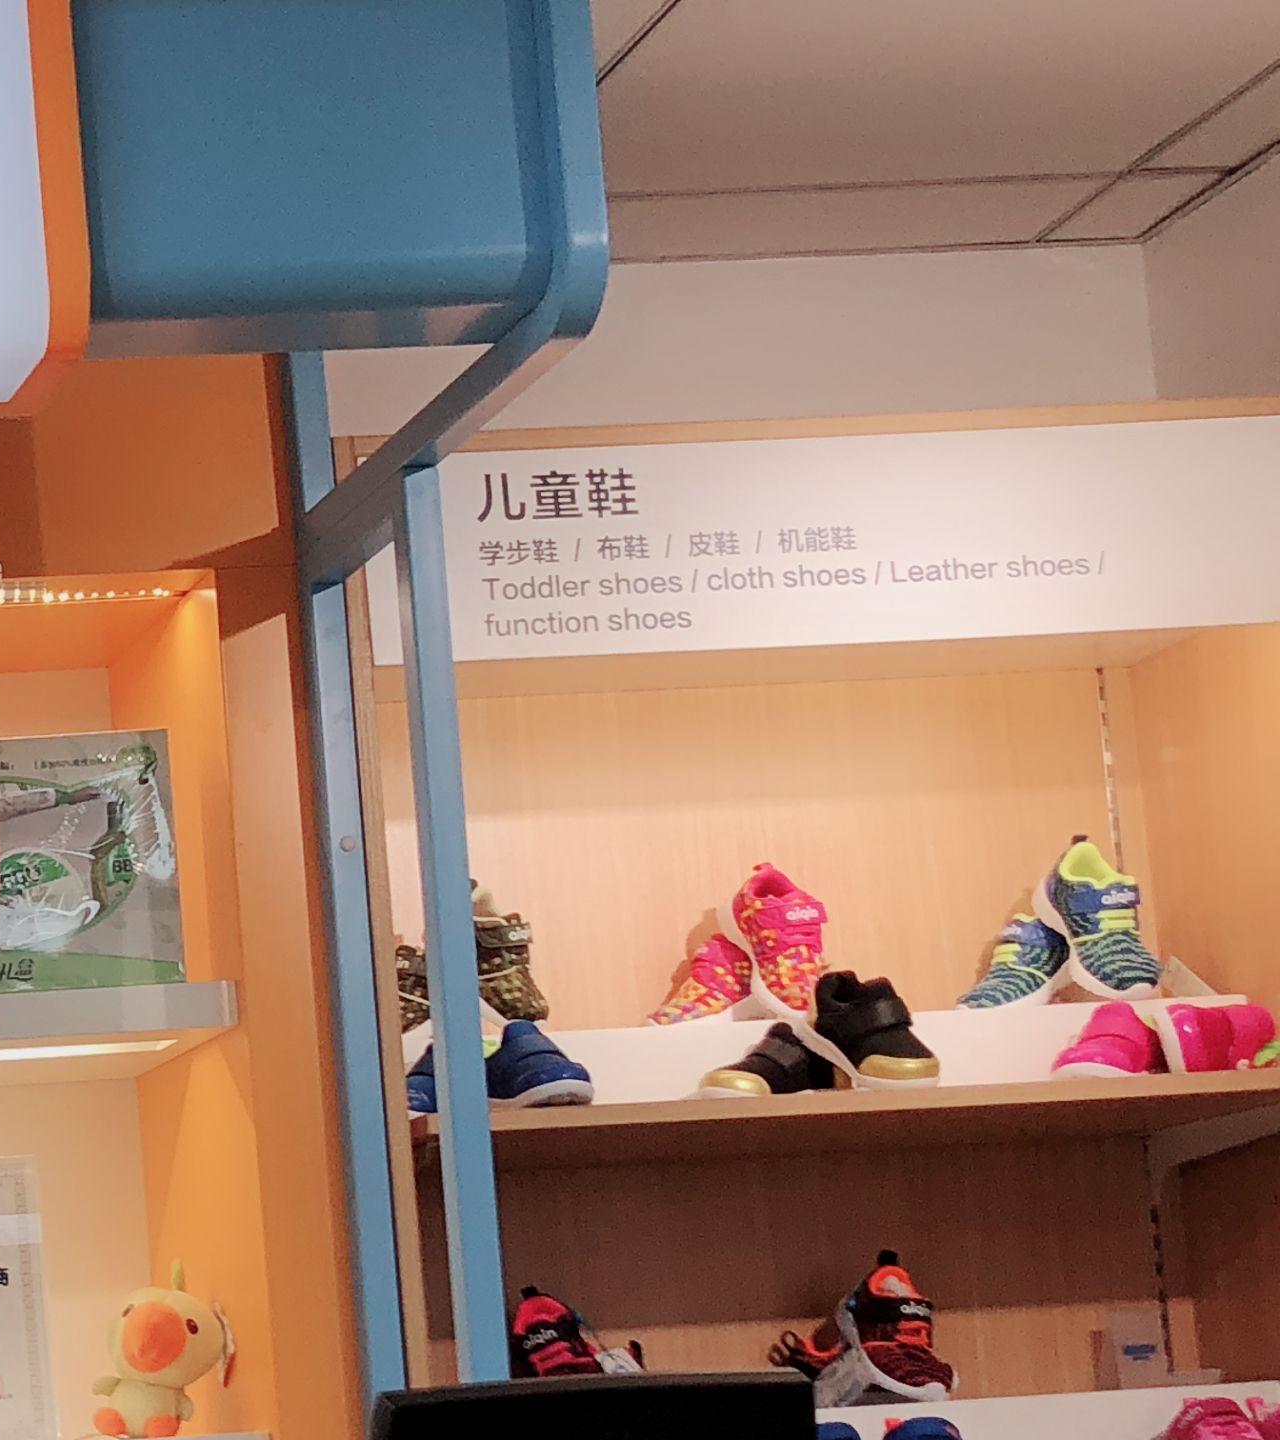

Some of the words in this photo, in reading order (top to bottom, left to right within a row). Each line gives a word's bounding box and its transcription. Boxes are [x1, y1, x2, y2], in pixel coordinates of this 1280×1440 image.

[476, 467, 640, 523] 儿童鞋
[478, 537, 559, 567] 学步鞋
[596, 535, 651, 563] 布鞋
[687, 530, 741, 559] 皮鞋
[777, 525, 858, 554] 机能鞋
[482, 574, 591, 602] Toddler
[597, 570, 684, 597] shoes
[706, 564, 776, 592] cloth
[782, 560, 868, 588] shoes
[890, 555, 998, 584] Leather
[1004, 551, 1091, 580] shoes
[484, 609, 601, 639] function
[606, 606, 693, 634] shoes
[785, 905, 820, 921] aiqin
[1100, 888, 1136, 905] aiqin
[523, 1328, 559, 1350] aiqin
